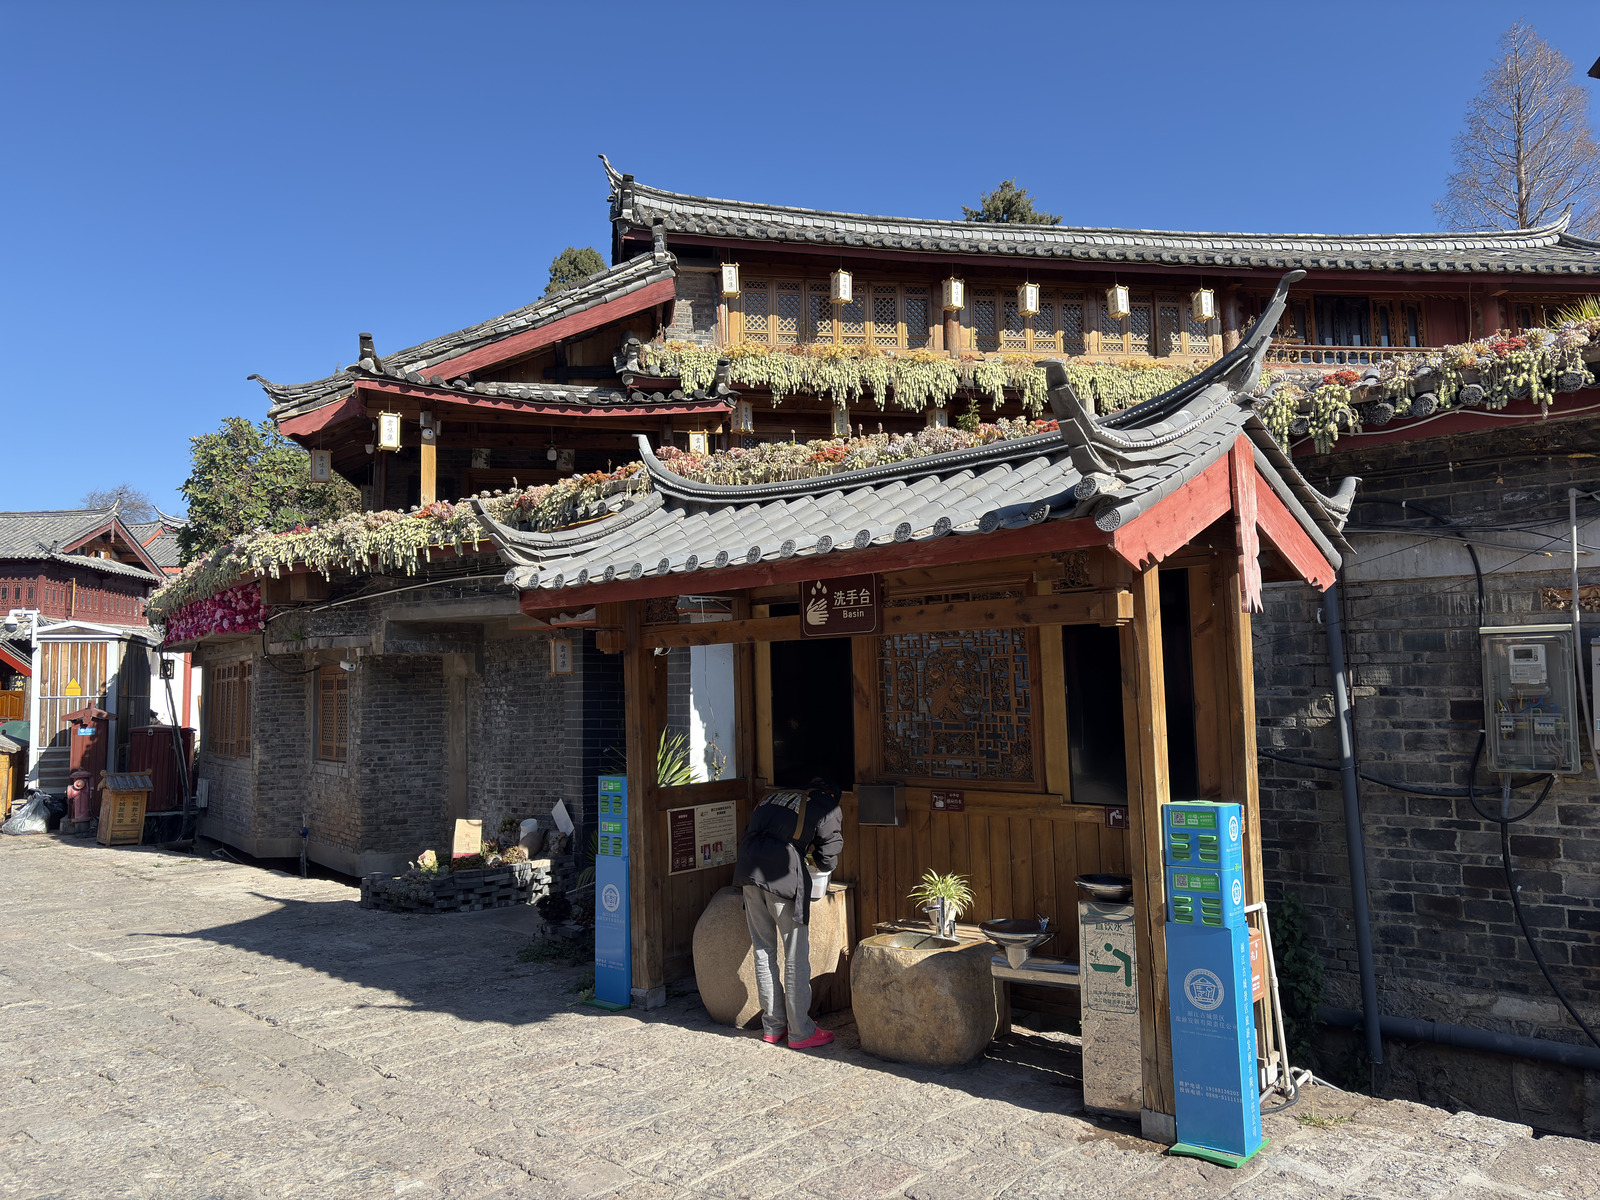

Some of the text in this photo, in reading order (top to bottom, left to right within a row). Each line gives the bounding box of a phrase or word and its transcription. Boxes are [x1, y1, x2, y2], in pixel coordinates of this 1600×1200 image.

[833, 588, 871, 606] 洗手台
[842, 609, 865, 619] Basin
